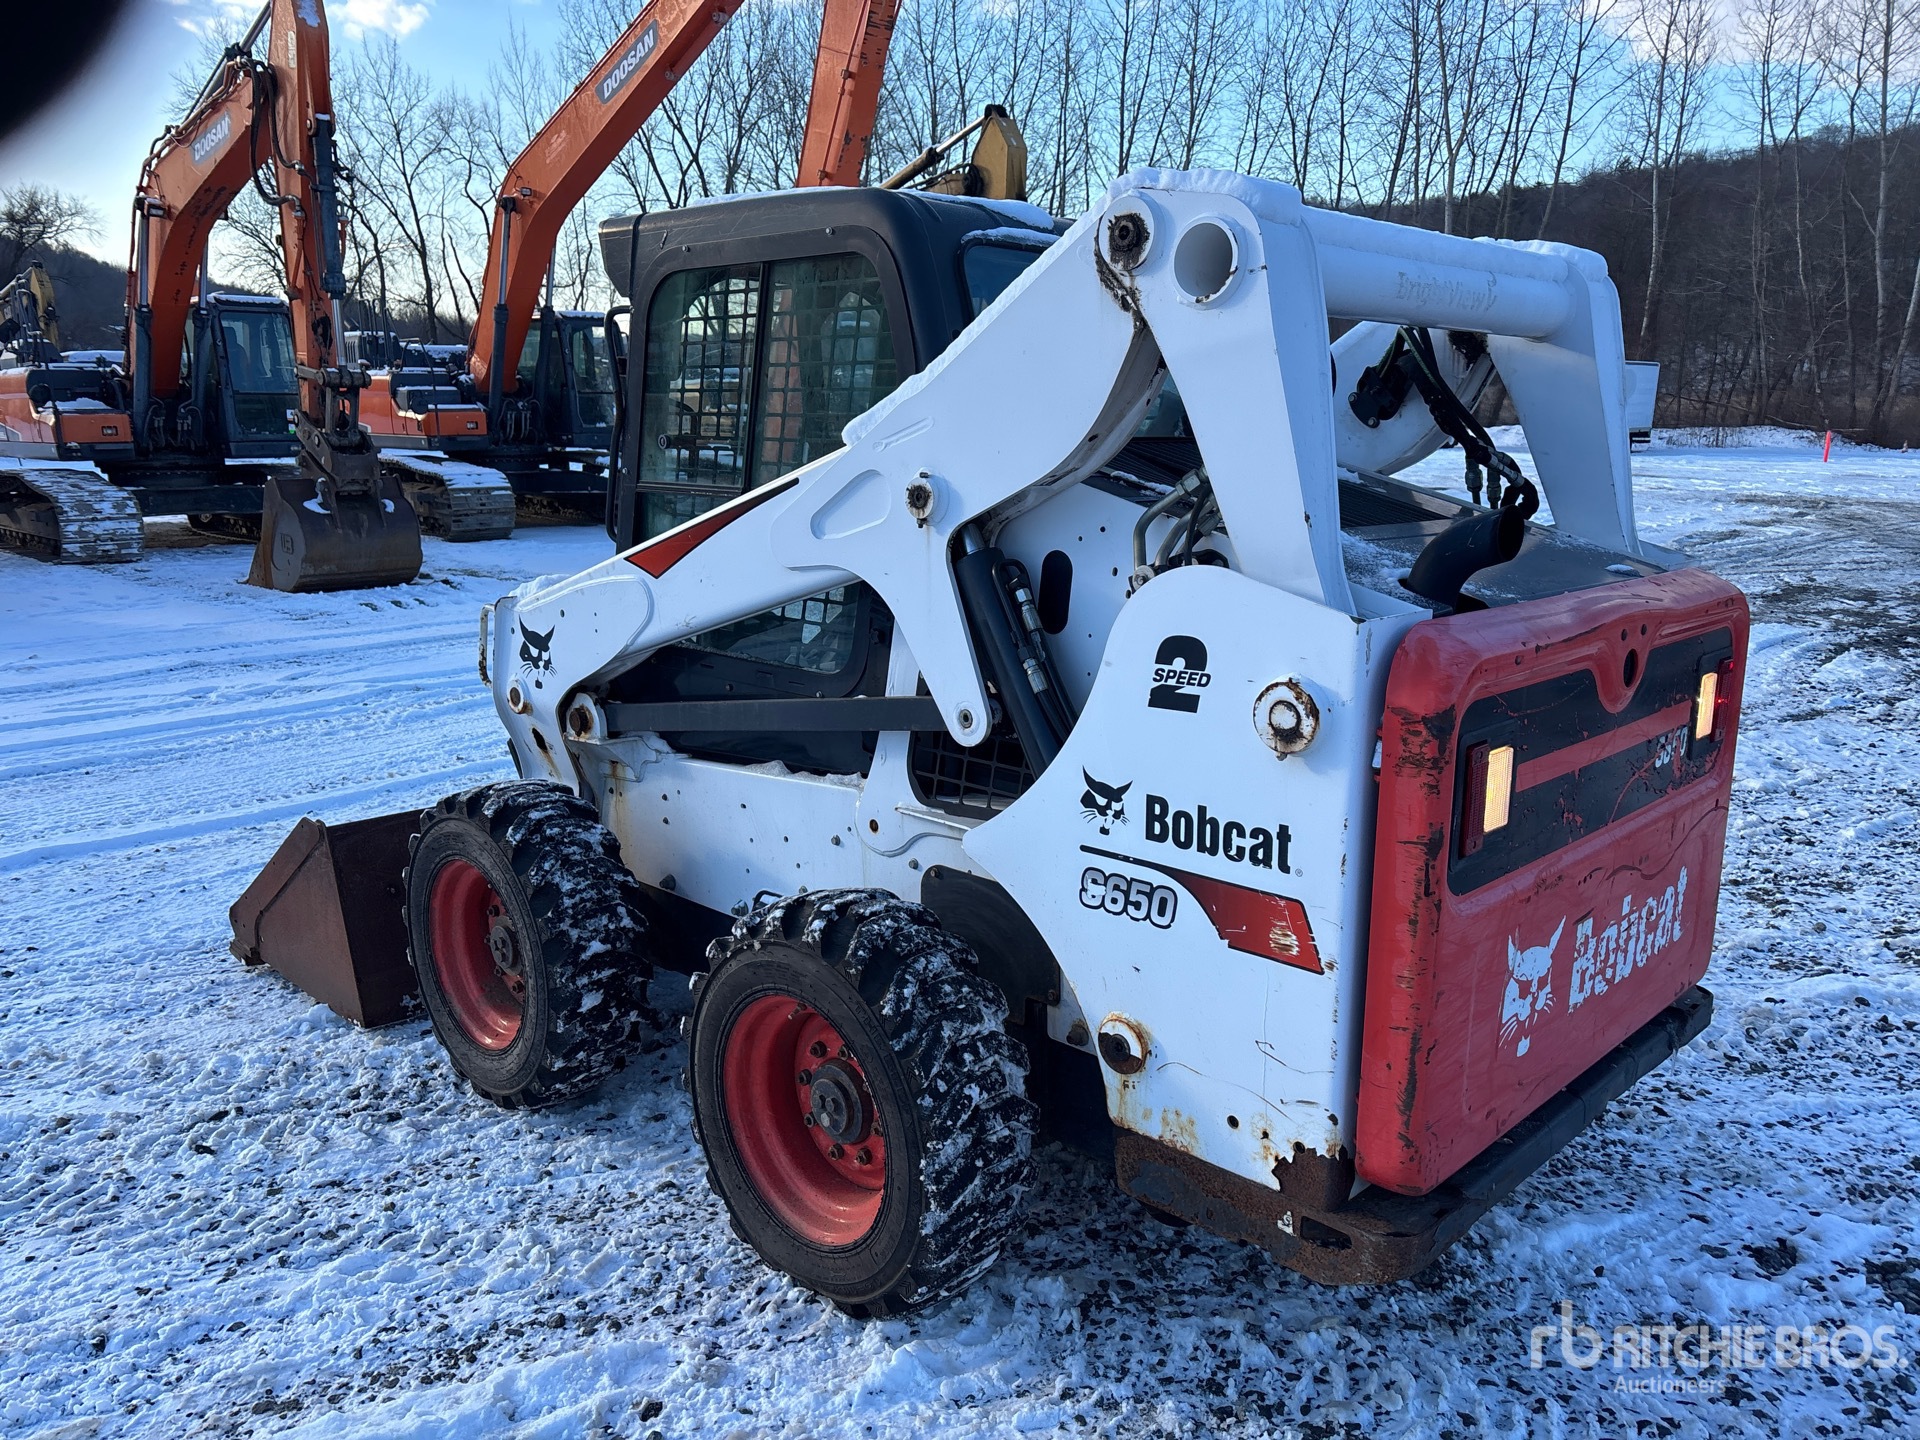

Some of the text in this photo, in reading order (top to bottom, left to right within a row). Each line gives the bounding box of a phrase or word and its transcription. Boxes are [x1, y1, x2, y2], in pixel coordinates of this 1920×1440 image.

[603, 28, 654, 99] DOOSAN
[194, 111, 232, 161] DOOSAN
[1395, 270, 1487, 313] BrigView
[1147, 634, 1208, 714] 2
[1152, 667, 1212, 688] SPEED
[1145, 793, 1293, 875] Bobcat
[1079, 866, 1178, 929] S650
